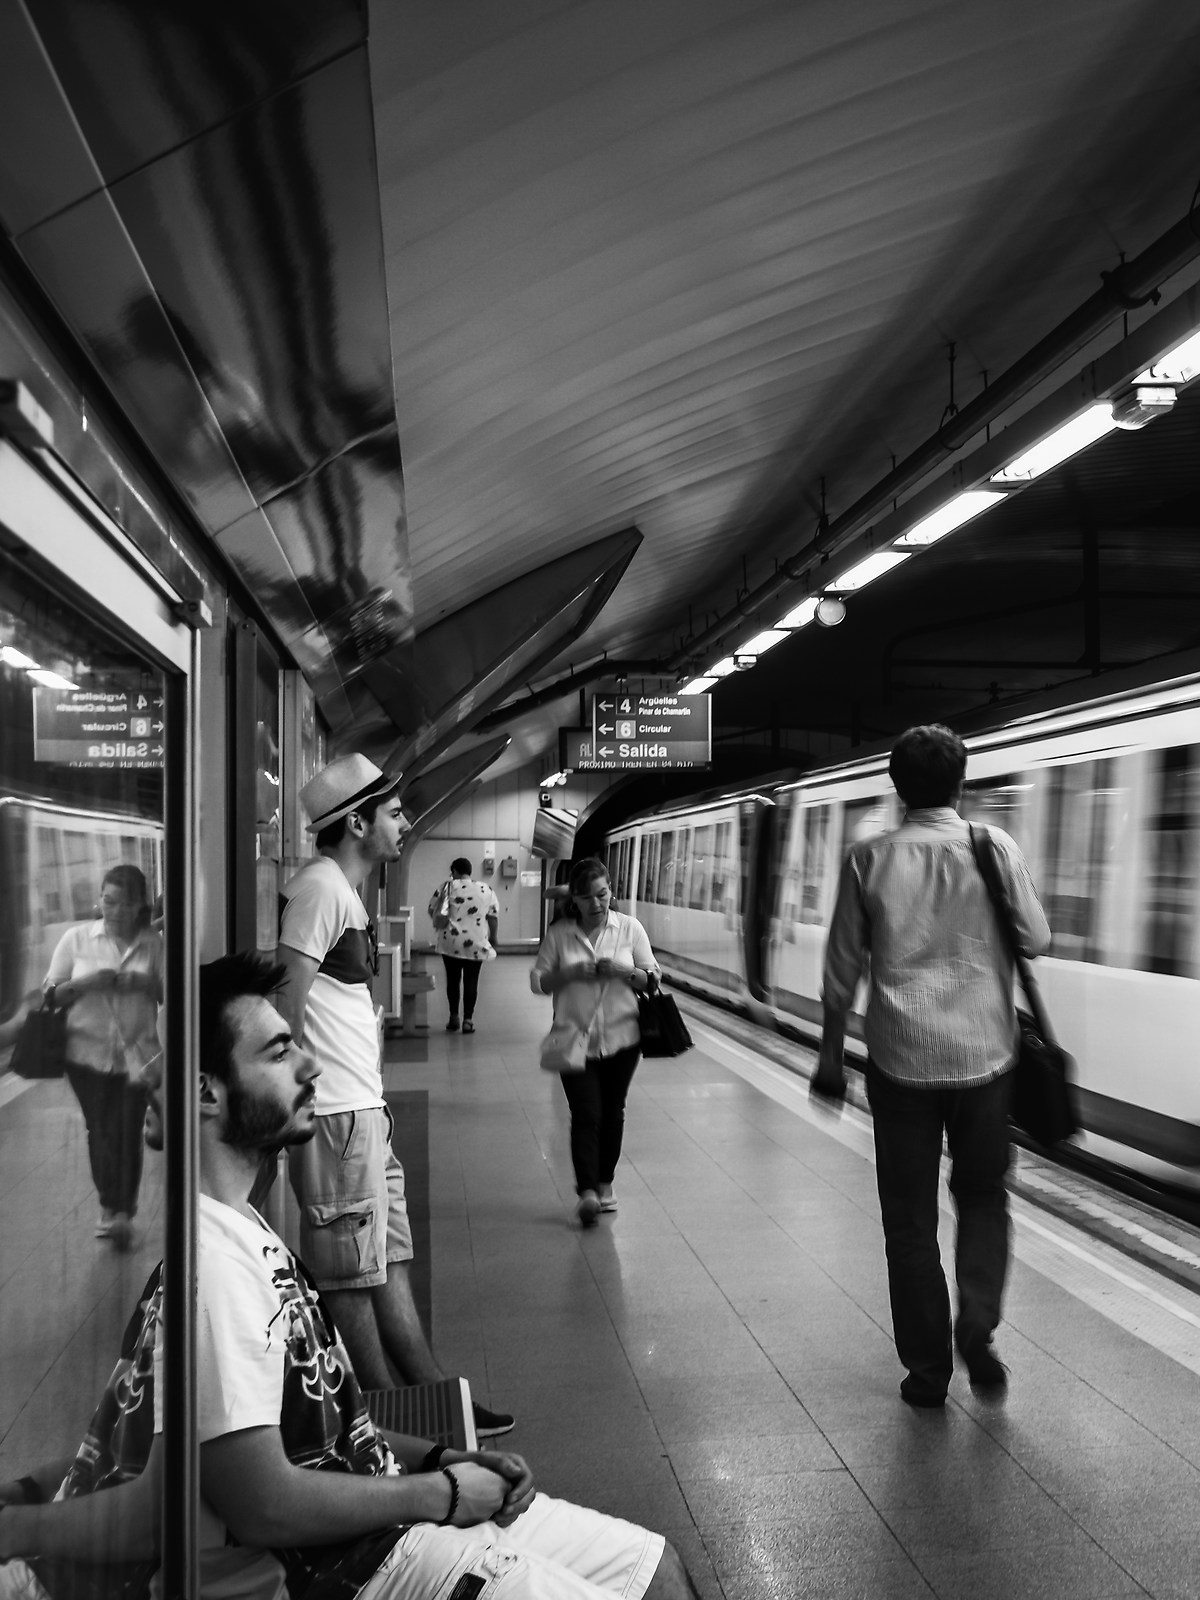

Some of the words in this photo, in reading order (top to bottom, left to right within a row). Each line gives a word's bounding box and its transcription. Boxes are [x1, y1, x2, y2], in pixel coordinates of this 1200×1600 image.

[620, 699, 631, 713] 4
[639, 697, 678, 707] Argüelles
[638, 707, 654, 716] Pinar
[620, 722, 632, 738] 6
[639, 724, 672, 733] Circular
[619, 743, 668, 758] Salida
